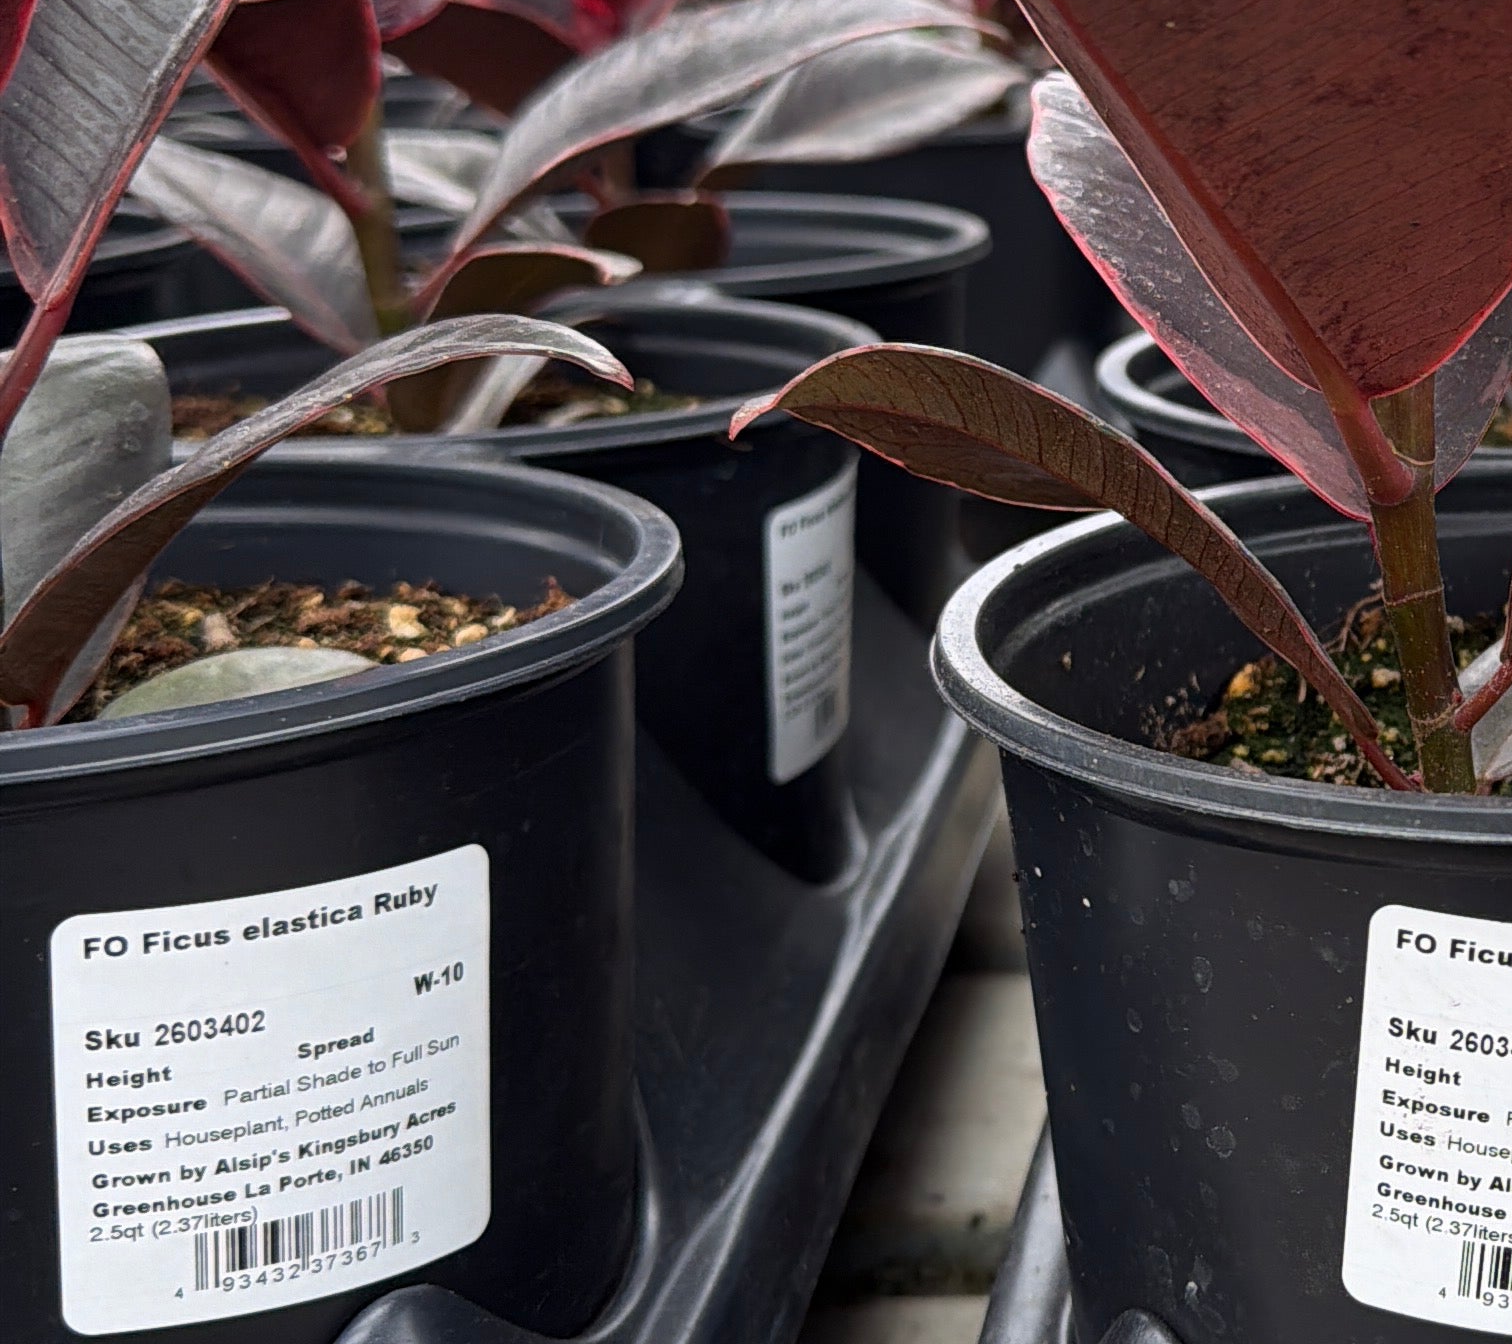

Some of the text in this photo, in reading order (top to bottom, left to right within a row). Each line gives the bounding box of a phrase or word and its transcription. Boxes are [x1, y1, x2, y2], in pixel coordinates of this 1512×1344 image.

[83, 883, 439, 960] FO Ficus elastica Ruby
[1396, 928, 1437, 955] FO
[413, 961, 464, 996] W-10
[84, 1009, 266, 1052] Sku 2603402
[297, 1026, 375, 1061] Spread
[1387, 1016, 1438, 1045] Sku
[86, 1066, 172, 1089] Height
[87, 1034, 460, 1124] Exposure Partial Shade to Full Sun
[1385, 1056, 1462, 1087] Height
[88, 1078, 429, 1156] Uses Houseplant, Potted Annuals
[1382, 1088, 1490, 1124] Exposure
[91, 1101, 457, 1190] Grown by Alsip's Kingsbury Acres
[1379, 1120, 1436, 1147] Uses
[92, 1134, 434, 1218] Greenhouse La Porte, IN 46350
[1379, 1154, 1449, 1183] Grown
[1456, 1169, 1482, 1192] by
[1371, 1203, 1419, 1230] 2.5qt
[1377, 1181, 1507, 1220] Greenhouse
[89, 1205, 260, 1243] 2.5qt (2.37liters)
[174, 1230, 421, 1299] 4 93432 37367 3
[1438, 1287, 1446, 1299] 4
